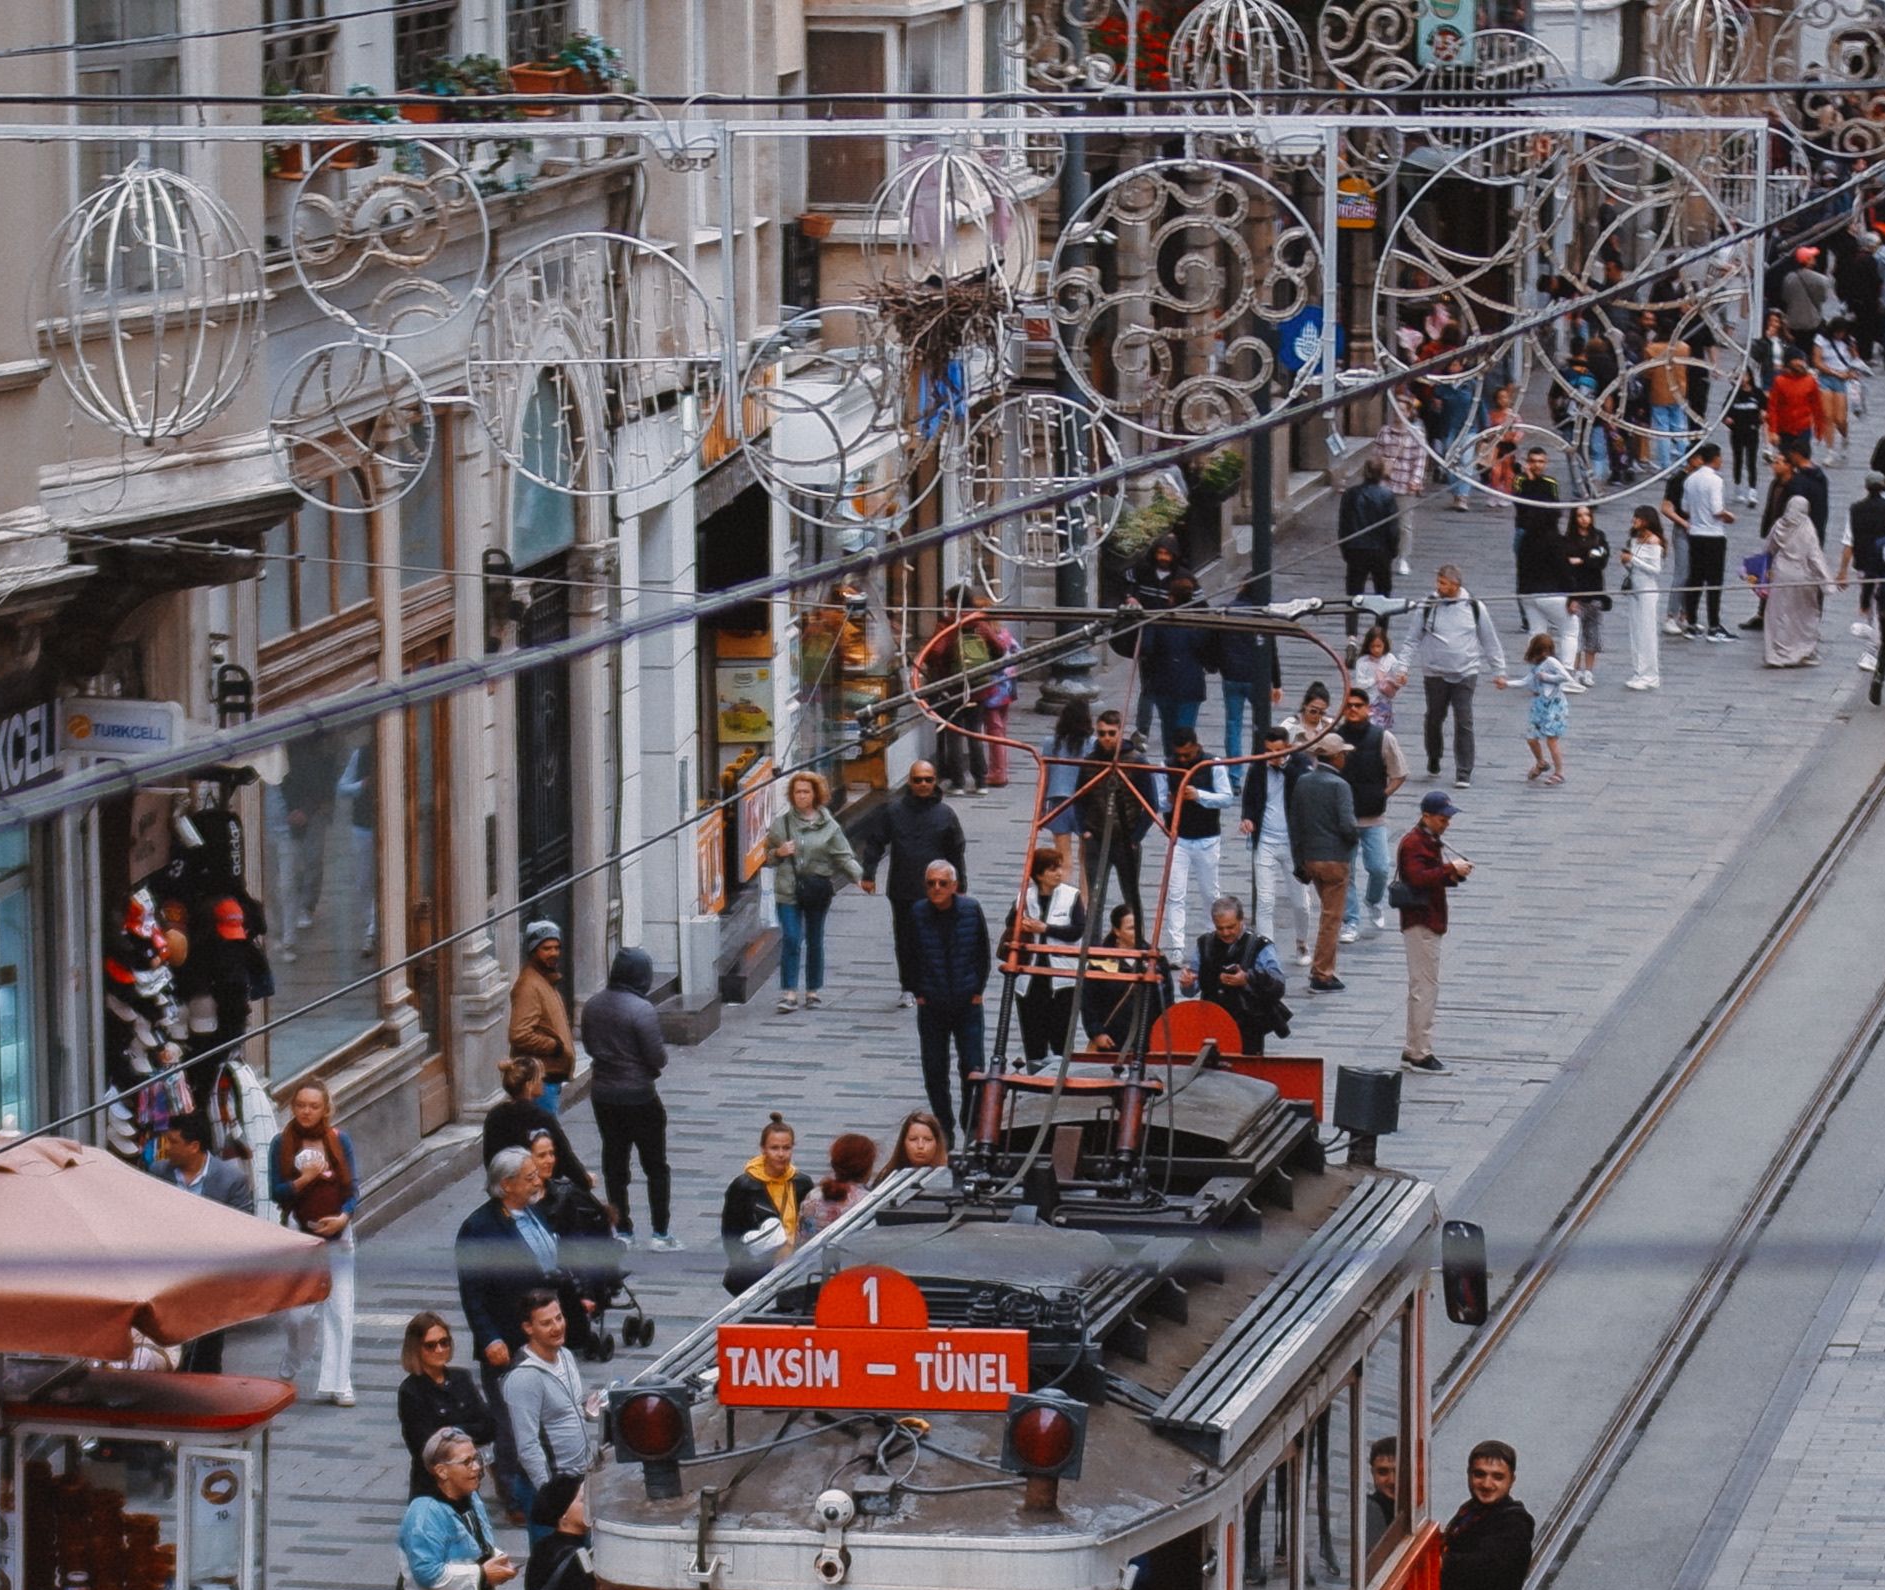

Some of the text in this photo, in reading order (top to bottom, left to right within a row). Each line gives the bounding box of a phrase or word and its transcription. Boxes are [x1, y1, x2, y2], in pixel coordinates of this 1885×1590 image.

[92, 722, 166, 740] TURKCELL
[862, 1275, 879, 1325] 1
[725, 1337, 840, 1389] TAKSİM
[915, 1341, 1017, 1394] TÜNEL
